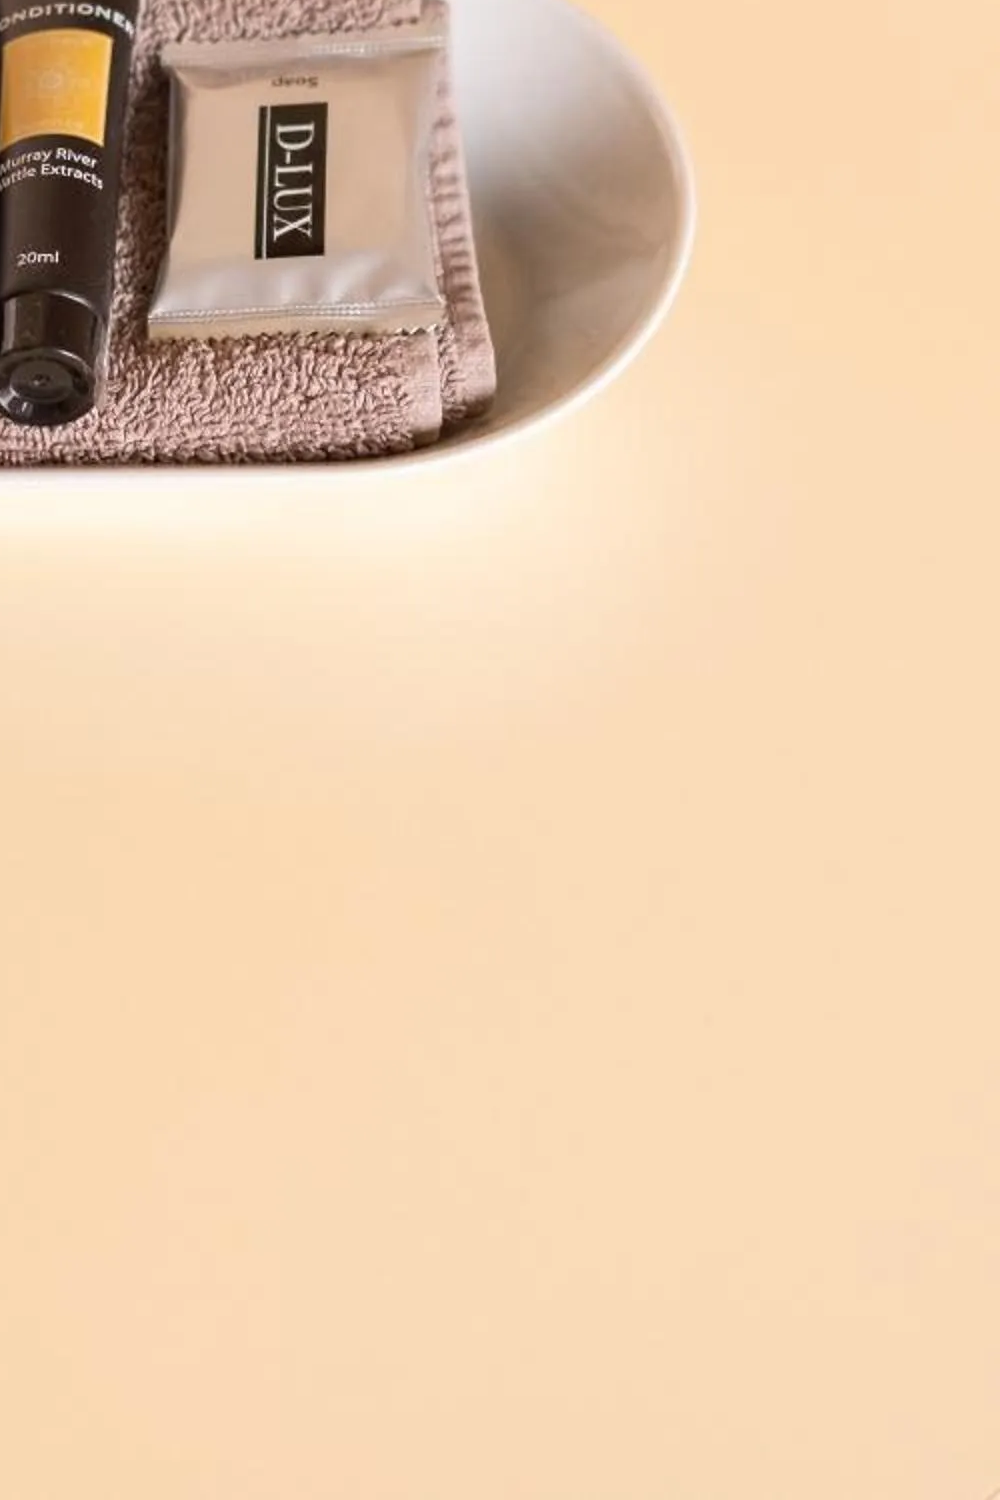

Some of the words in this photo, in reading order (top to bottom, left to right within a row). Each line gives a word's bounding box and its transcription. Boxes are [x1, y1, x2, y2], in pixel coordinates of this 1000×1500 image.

[271, 75, 319, 88] Soap
[0, 149, 53, 177] Murray
[55, 147, 98, 168] River
[41, 163, 104, 190] Extracts
[273, 121, 315, 242] D-LUX
[16, 251, 60, 266] 20ml
